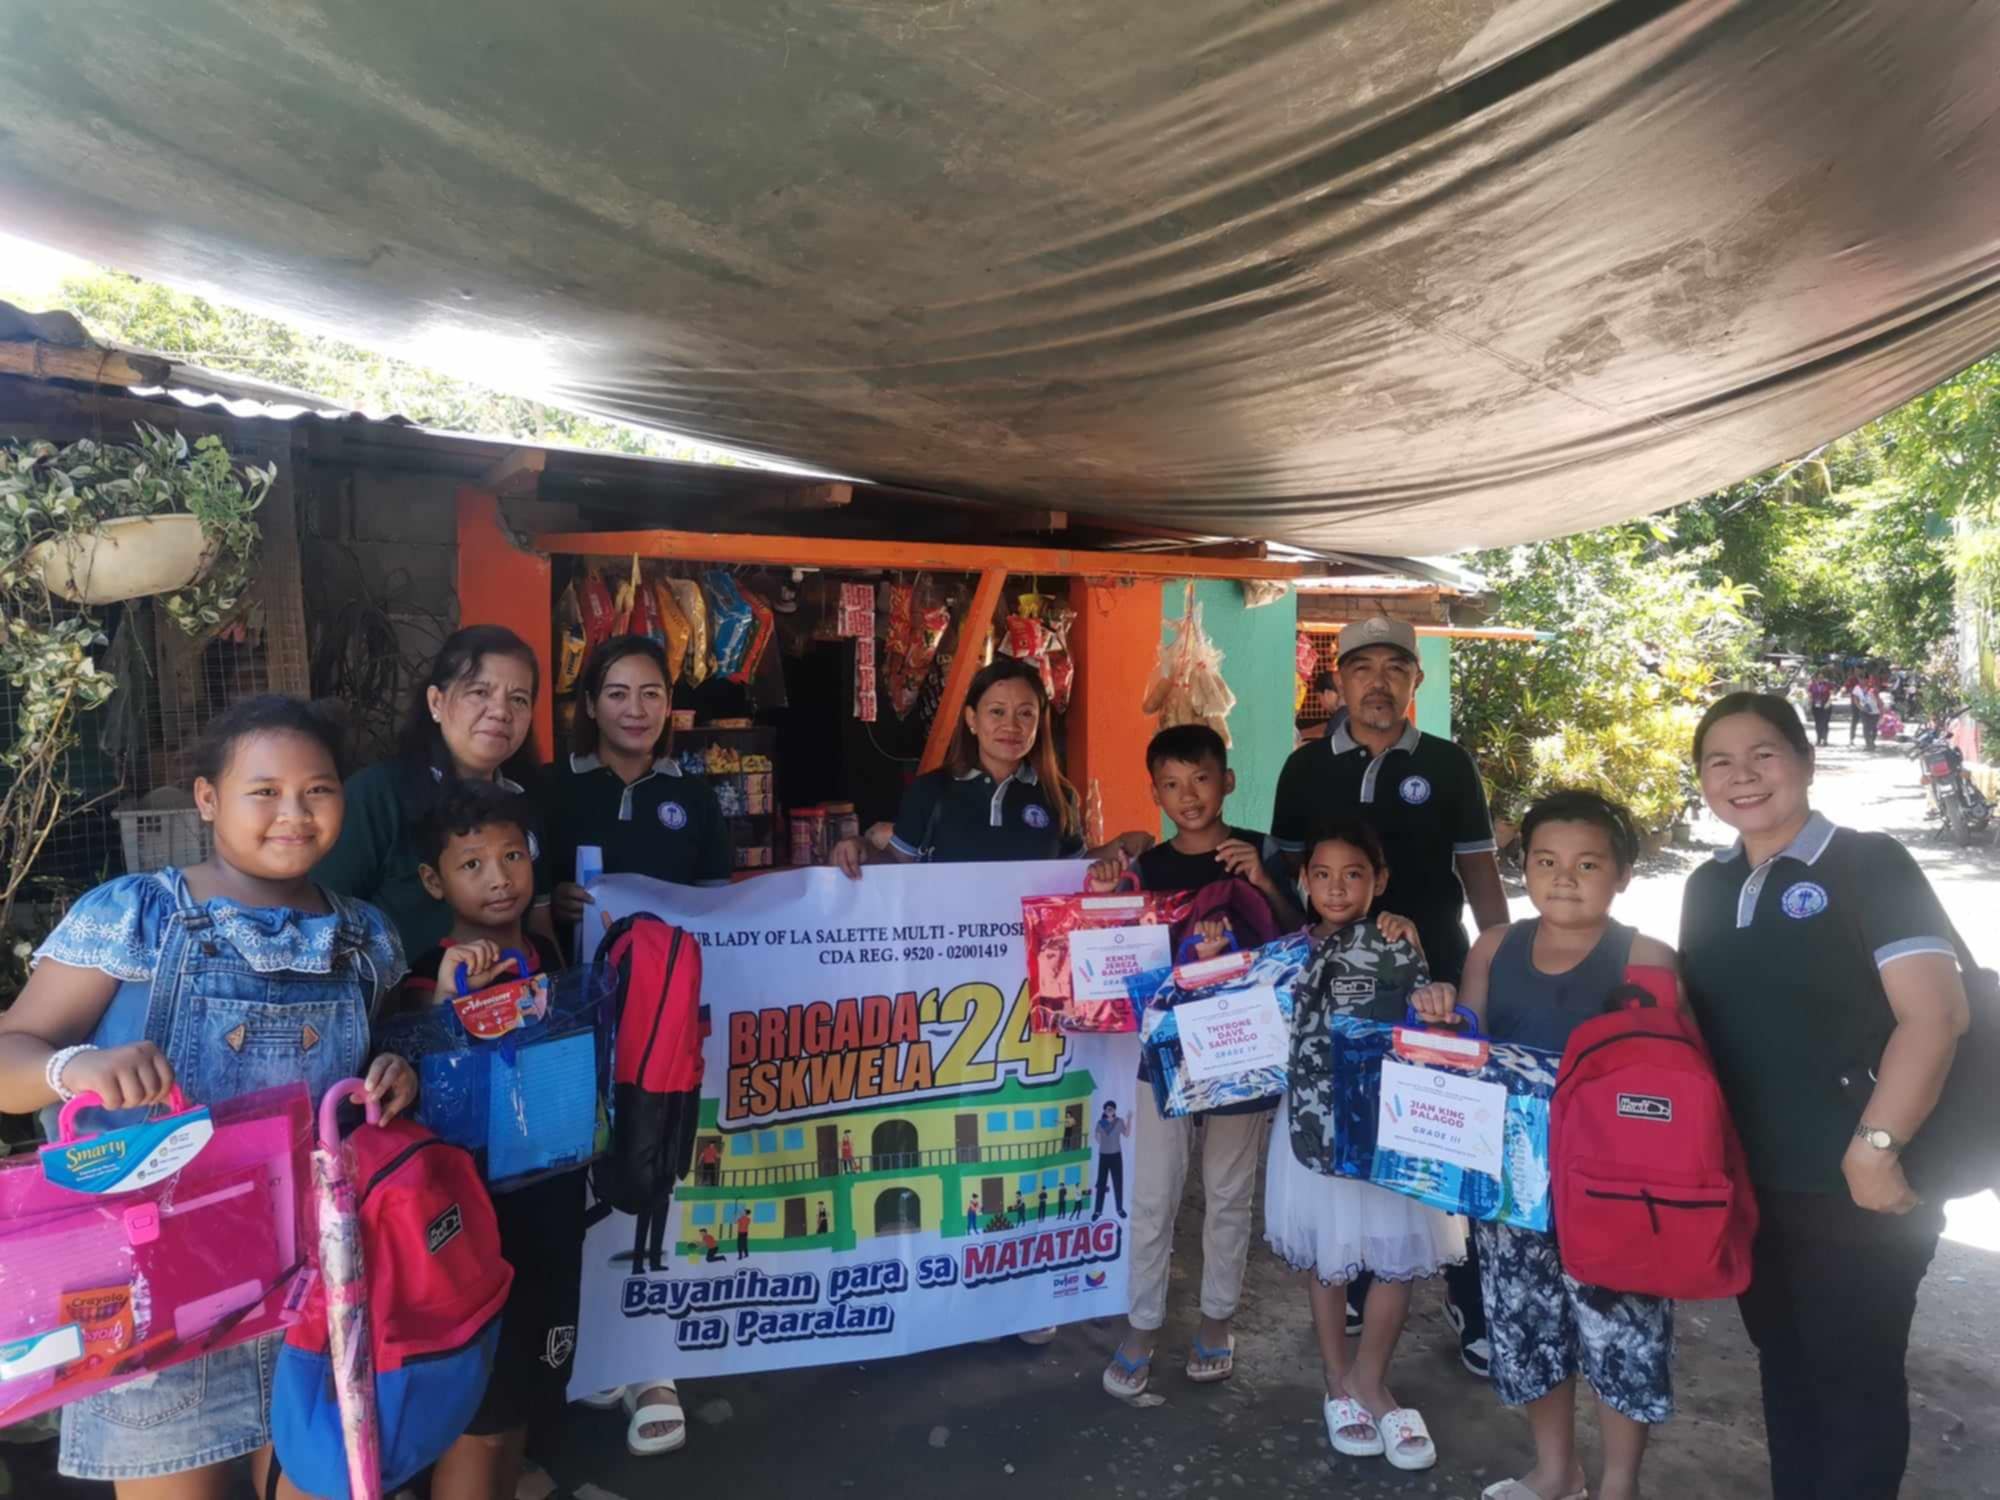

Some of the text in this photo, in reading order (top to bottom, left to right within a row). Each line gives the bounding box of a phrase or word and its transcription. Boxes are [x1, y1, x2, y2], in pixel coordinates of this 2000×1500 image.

[715, 931, 761, 947] LADY
[765, 930, 787, 945] OF
[791, 930, 812, 945] LA
[816, 927, 888, 944] SALETTE
[892, 925, 945, 941] MULTI
[819, 950, 856, 965] CDA
[860, 947, 899, 963] REG.
[903, 946, 934, 961] 9520
[946, 943, 1008, 960] 02001419
[728, 990, 921, 1067] BRIGADA
[1217, 1028, 1244, 1040] DAVE
[1208, 1033, 1258, 1050] SANTIAGO
[1215, 1047, 1244, 1058] GRADE
[725, 1040, 934, 1121] ESKWELA
[1409, 1100, 1465, 1120] JIAN KING
[1412, 1126, 1447, 1140] GRADE
[65, 1139, 126, 1168] Smarty
[623, 1222, 1115, 1310] Bayanihan para sa MATATAG
[677, 1303, 888, 1342] na Paaralan
